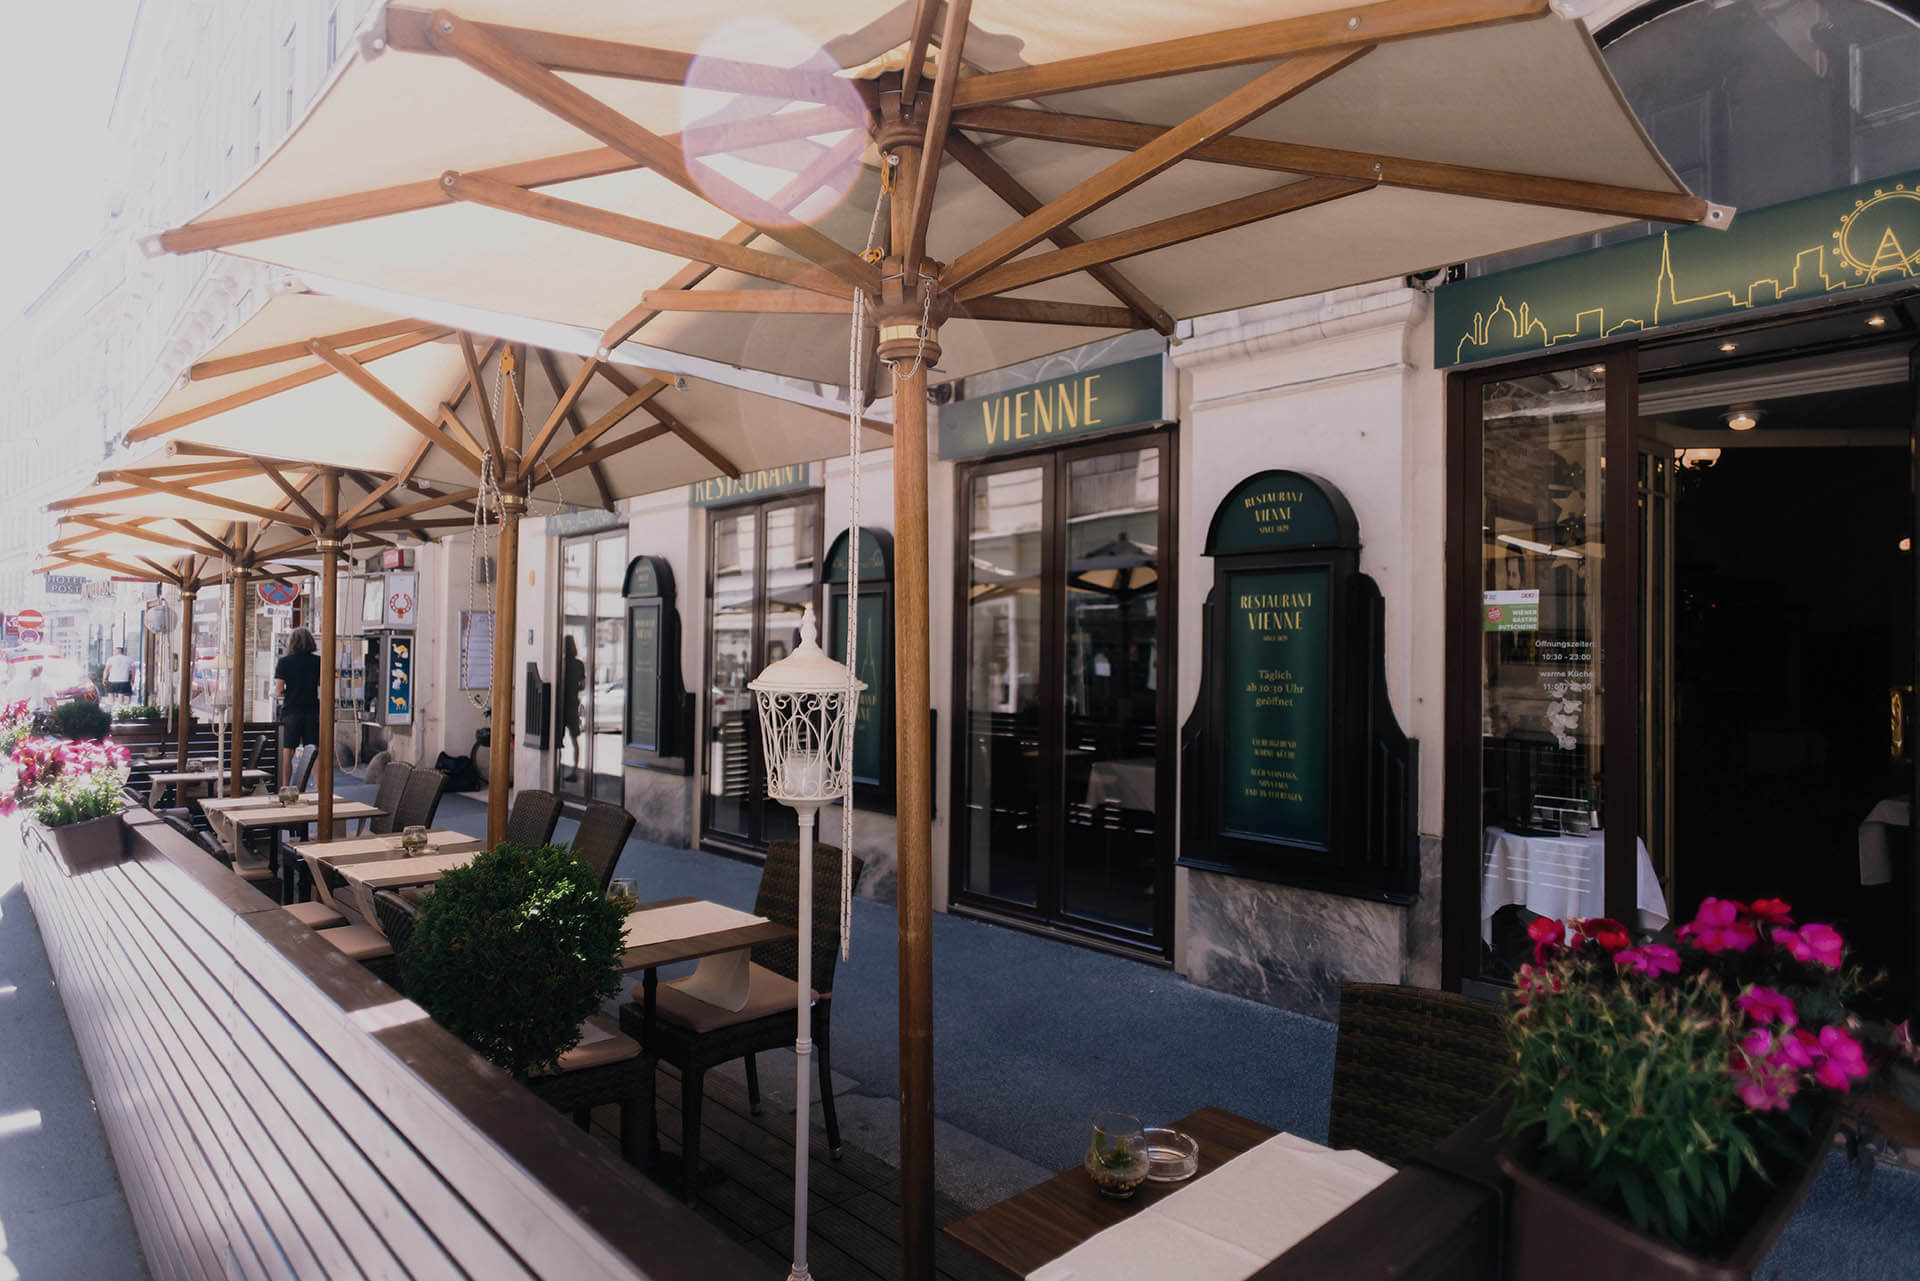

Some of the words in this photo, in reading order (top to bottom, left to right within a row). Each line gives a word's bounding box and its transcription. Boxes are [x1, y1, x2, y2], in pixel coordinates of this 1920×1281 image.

[982, 375, 1101, 444] VIENNE
[1244, 491, 1304, 508] RESTAURANT
[1255, 506, 1292, 522] VIENNE
[1240, 592, 1312, 609] RESTAURANT
[1248, 611, 1304, 630] VIENNE
[1542, 653, 1563, 661] 10:30
[1568, 653, 1593, 661] 23:00
[1257, 669, 1292, 682] Täglich
[1285, 682, 1305, 694] Uhr
